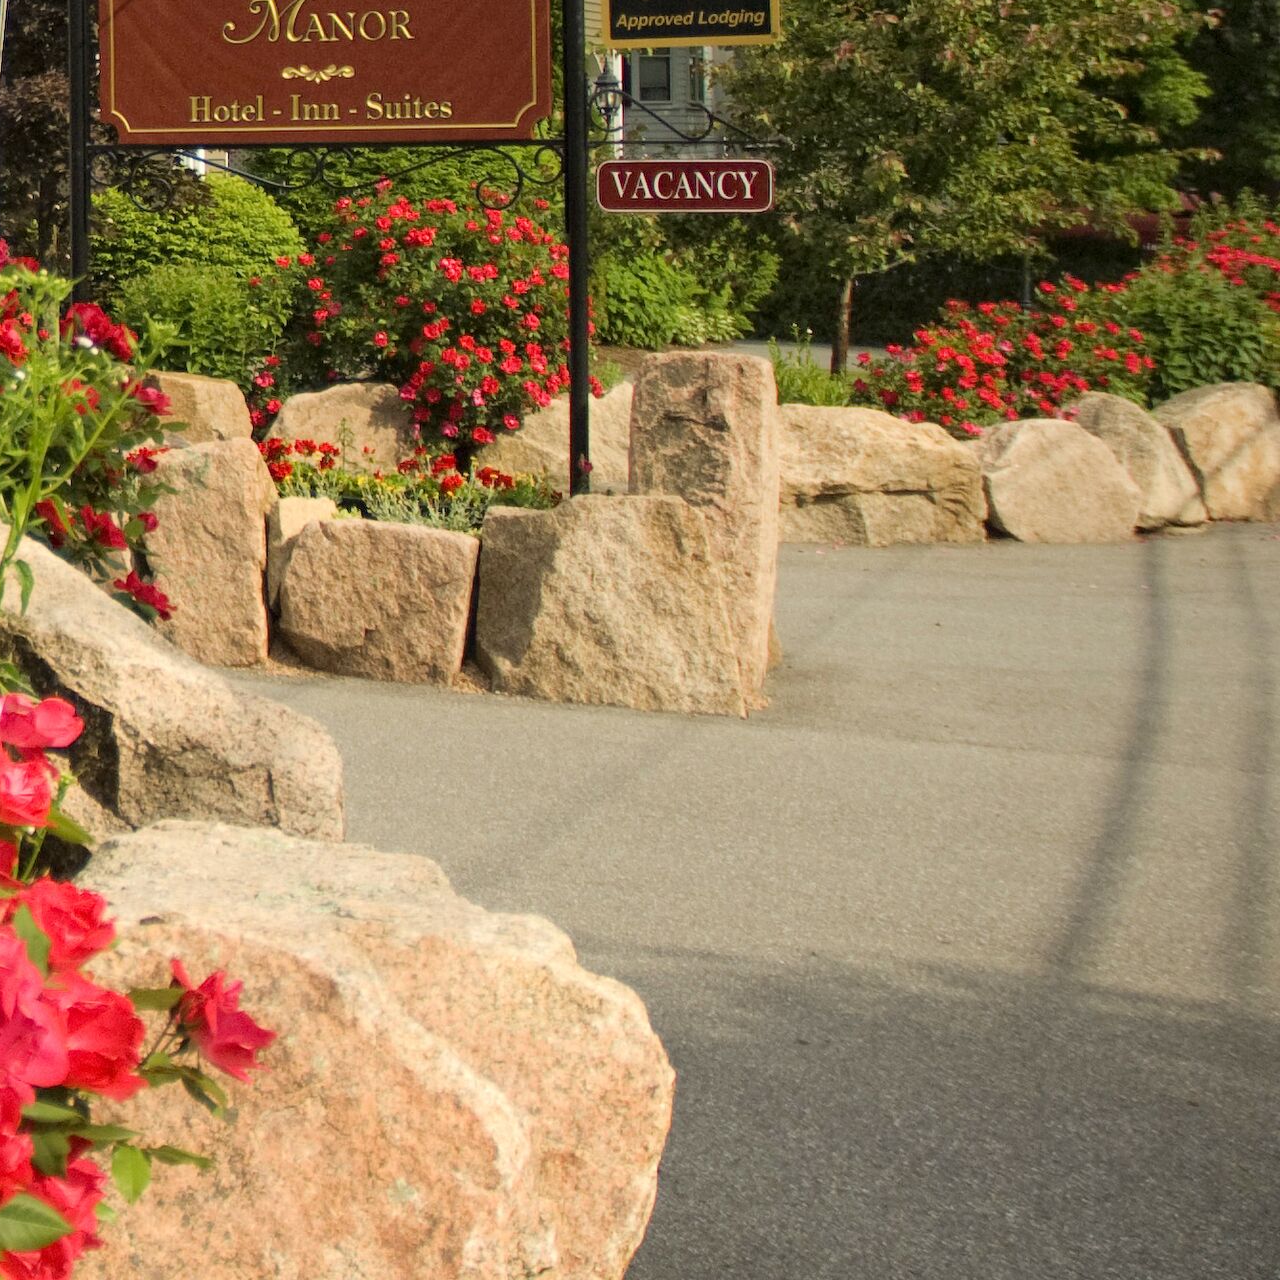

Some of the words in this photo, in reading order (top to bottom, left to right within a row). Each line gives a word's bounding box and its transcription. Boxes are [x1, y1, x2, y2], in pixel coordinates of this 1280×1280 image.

[616, 11, 694, 31] Approved
[698, 9, 765, 28] Lodging
[190, 95, 265, 122] Hotel
[290, 94, 340, 121] Inn
[366, 93, 452, 120] Suites
[611, 171, 759, 200] VACANCY
